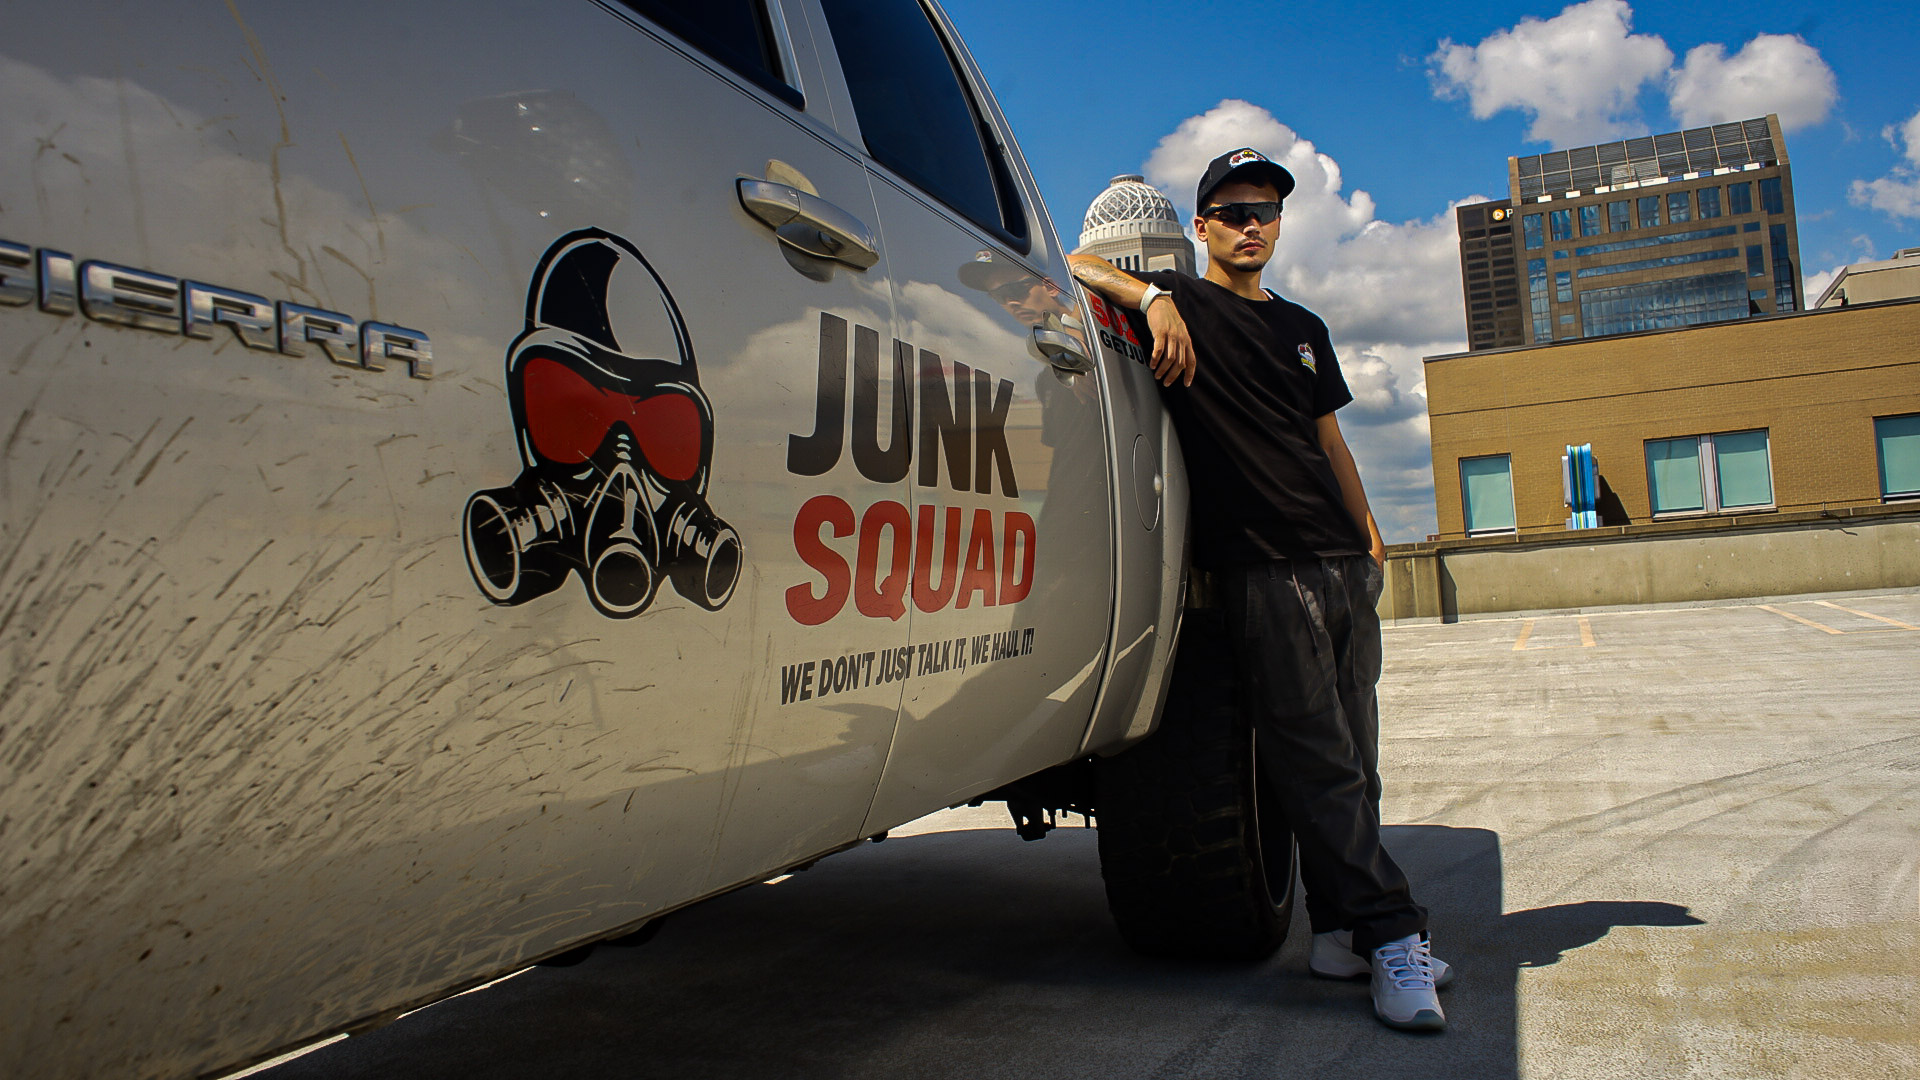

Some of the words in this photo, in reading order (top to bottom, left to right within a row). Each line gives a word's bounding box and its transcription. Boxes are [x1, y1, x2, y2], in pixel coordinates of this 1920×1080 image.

[0, 238, 433, 380] IERRA
[786, 311, 1019, 498] JUNK
[785, 495, 1036, 625] SQUAD
[781, 661, 815, 705] WE
[818, 651, 875, 697] DON'T
[876, 645, 915, 685] JUST
[917, 640, 951, 676] TALK
[953, 637, 966, 675] IT,
[971, 633, 990, 665] WE
[991, 629, 1019, 662] HAUL
[1021, 627, 1035, 656] IT!
